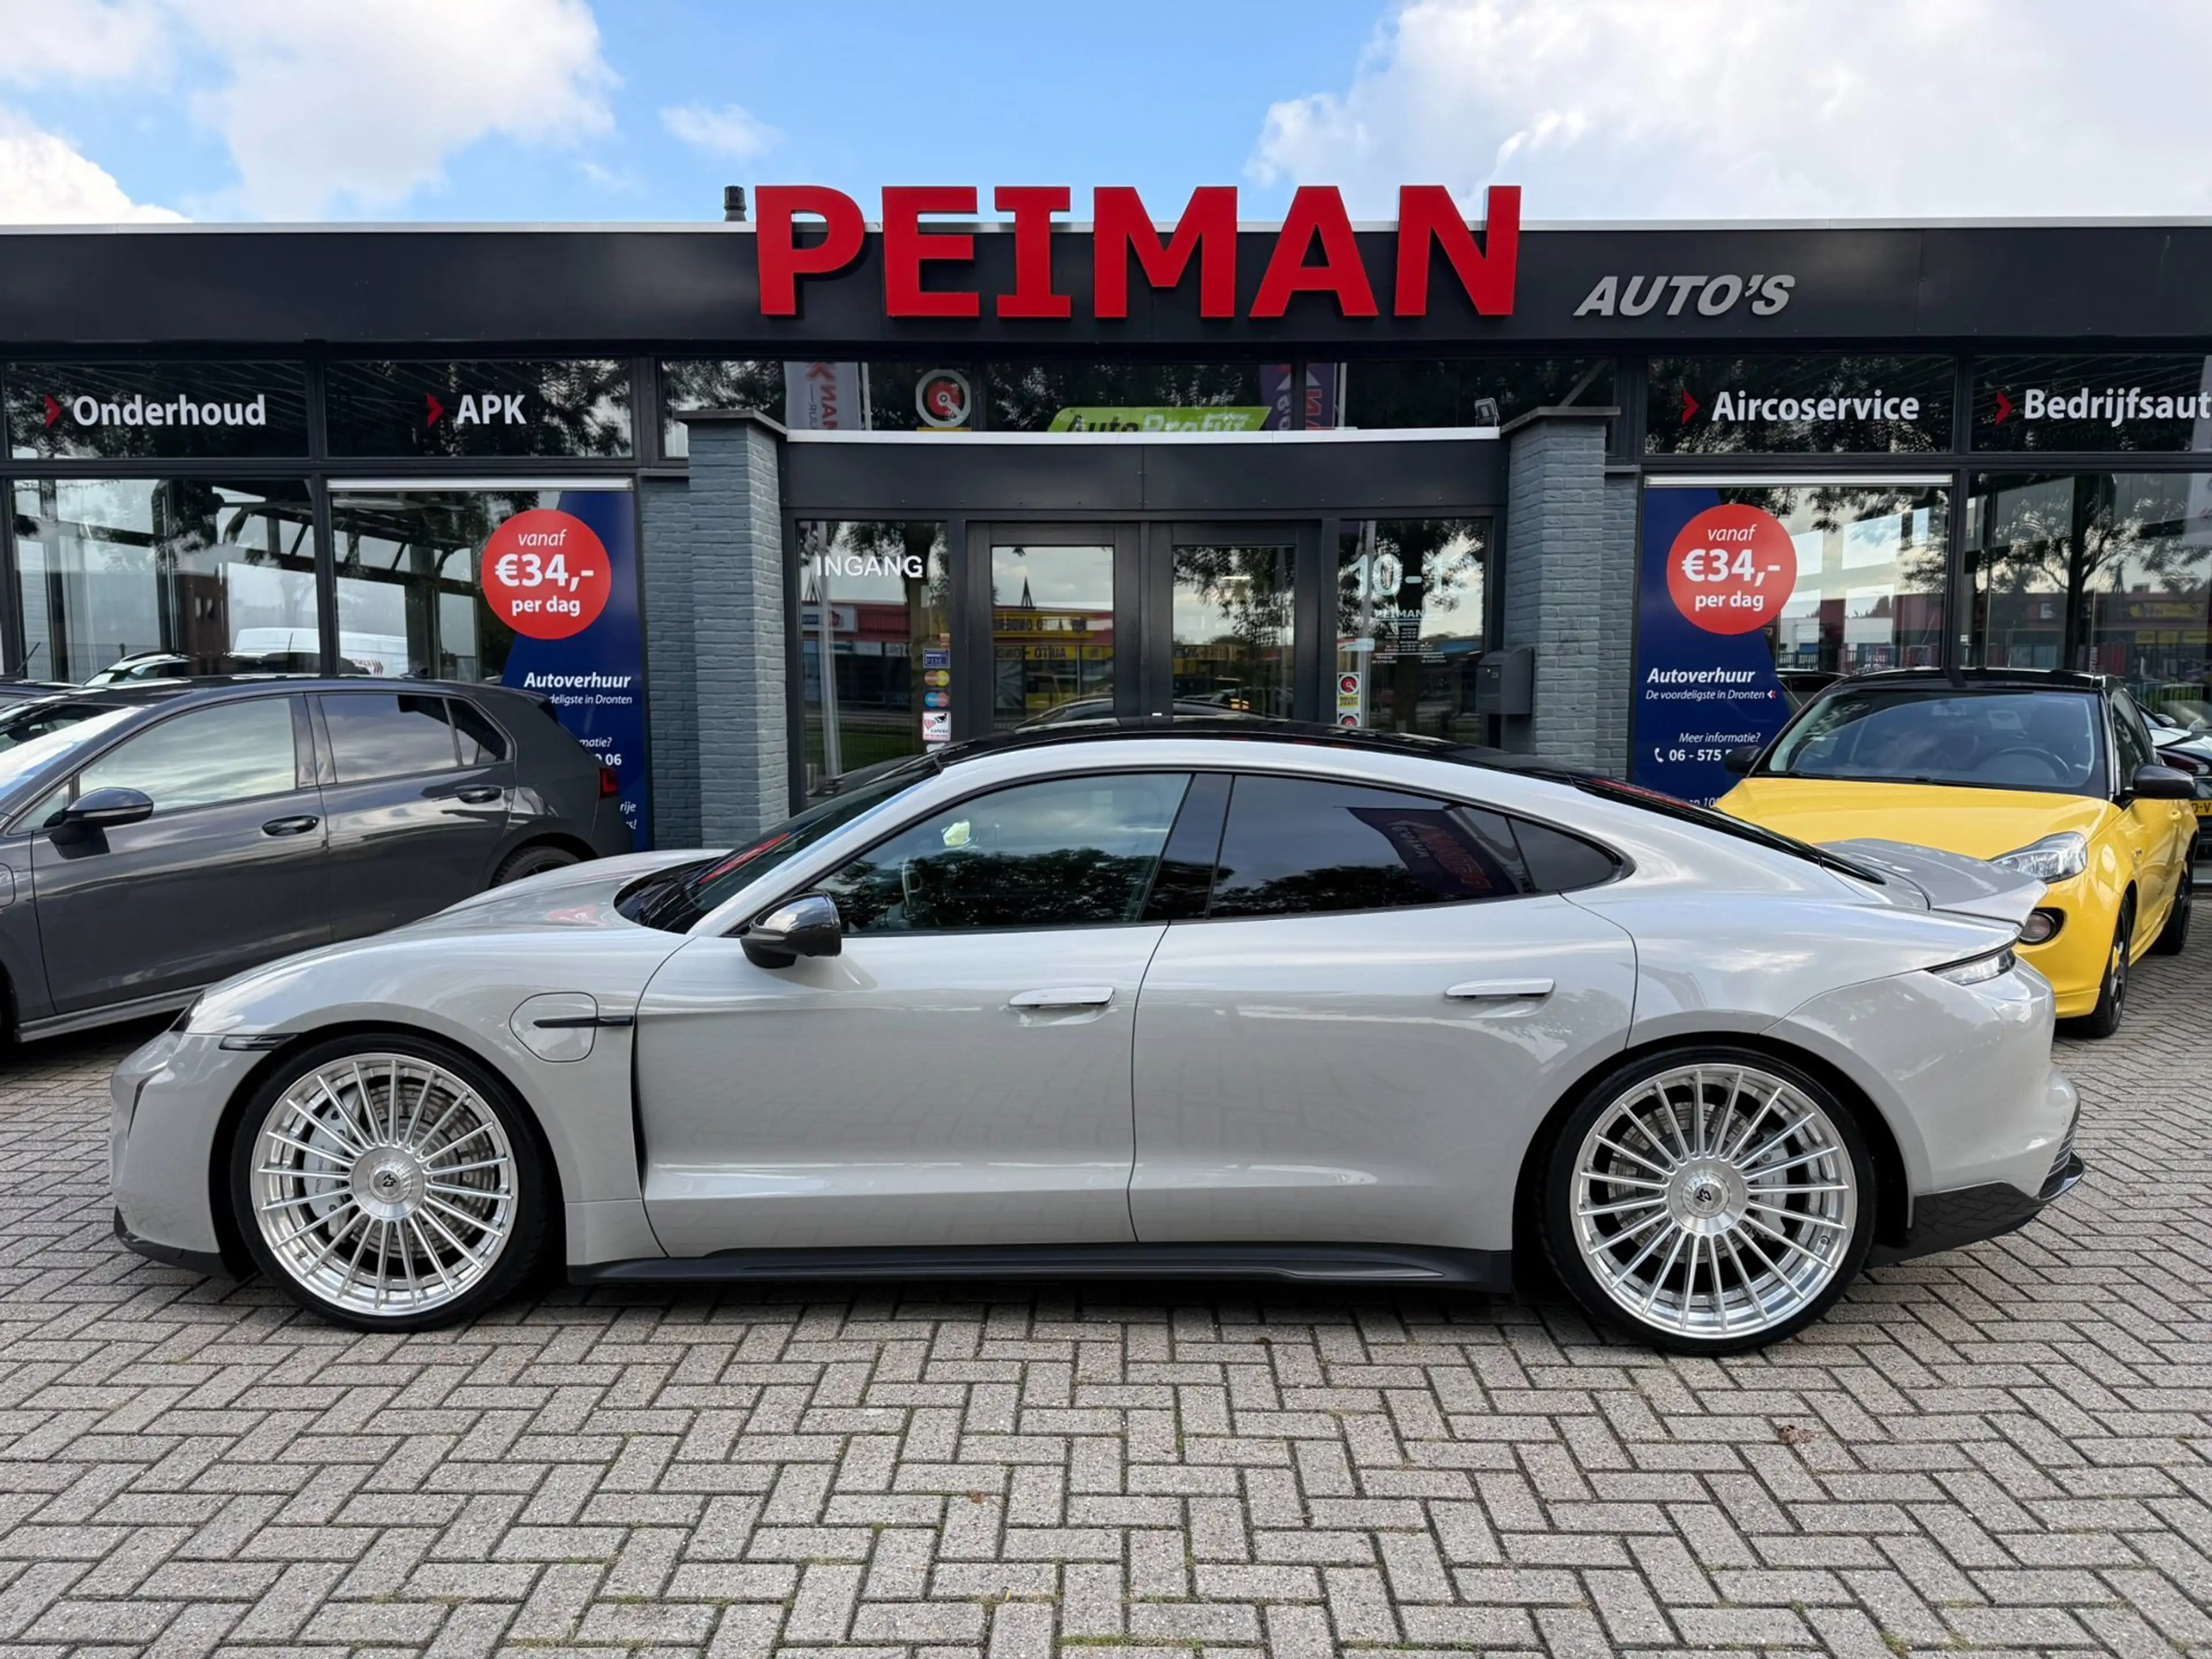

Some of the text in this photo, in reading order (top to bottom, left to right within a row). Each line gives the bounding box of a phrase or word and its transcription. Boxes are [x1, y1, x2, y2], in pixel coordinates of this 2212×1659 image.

[755, 185, 1522, 318] PEIMAN
[1573, 274, 1796, 316] AUTO'S
[73, 395, 267, 427] Onderhoud
[456, 395, 527, 425] APK
[1712, 389, 1920, 422] Aircoservice
[518, 529, 567, 547] vanaf
[1707, 524, 1757, 542] vanaf
[495, 554, 594, 592] €34,-
[816, 555, 923, 578] INGANG
[1681, 548, 1781, 587] €34,-
[512, 596, 581, 616] per dag
[1695, 591, 1764, 612] per dag
[524, 672, 632, 688] Autoverhuur
[1646, 667, 1756, 684] Autoverhuur
[585, 694, 594, 704] in
[595, 694, 632, 704] Dronten
[1646, 690, 1765, 701] De voordeligste in Dronten
[1678, 732, 1761, 743] Meer informatie?
[605, 753, 622, 766] 06
[1669, 749, 1685, 762] 06
[1696, 749, 1722, 762] 575
